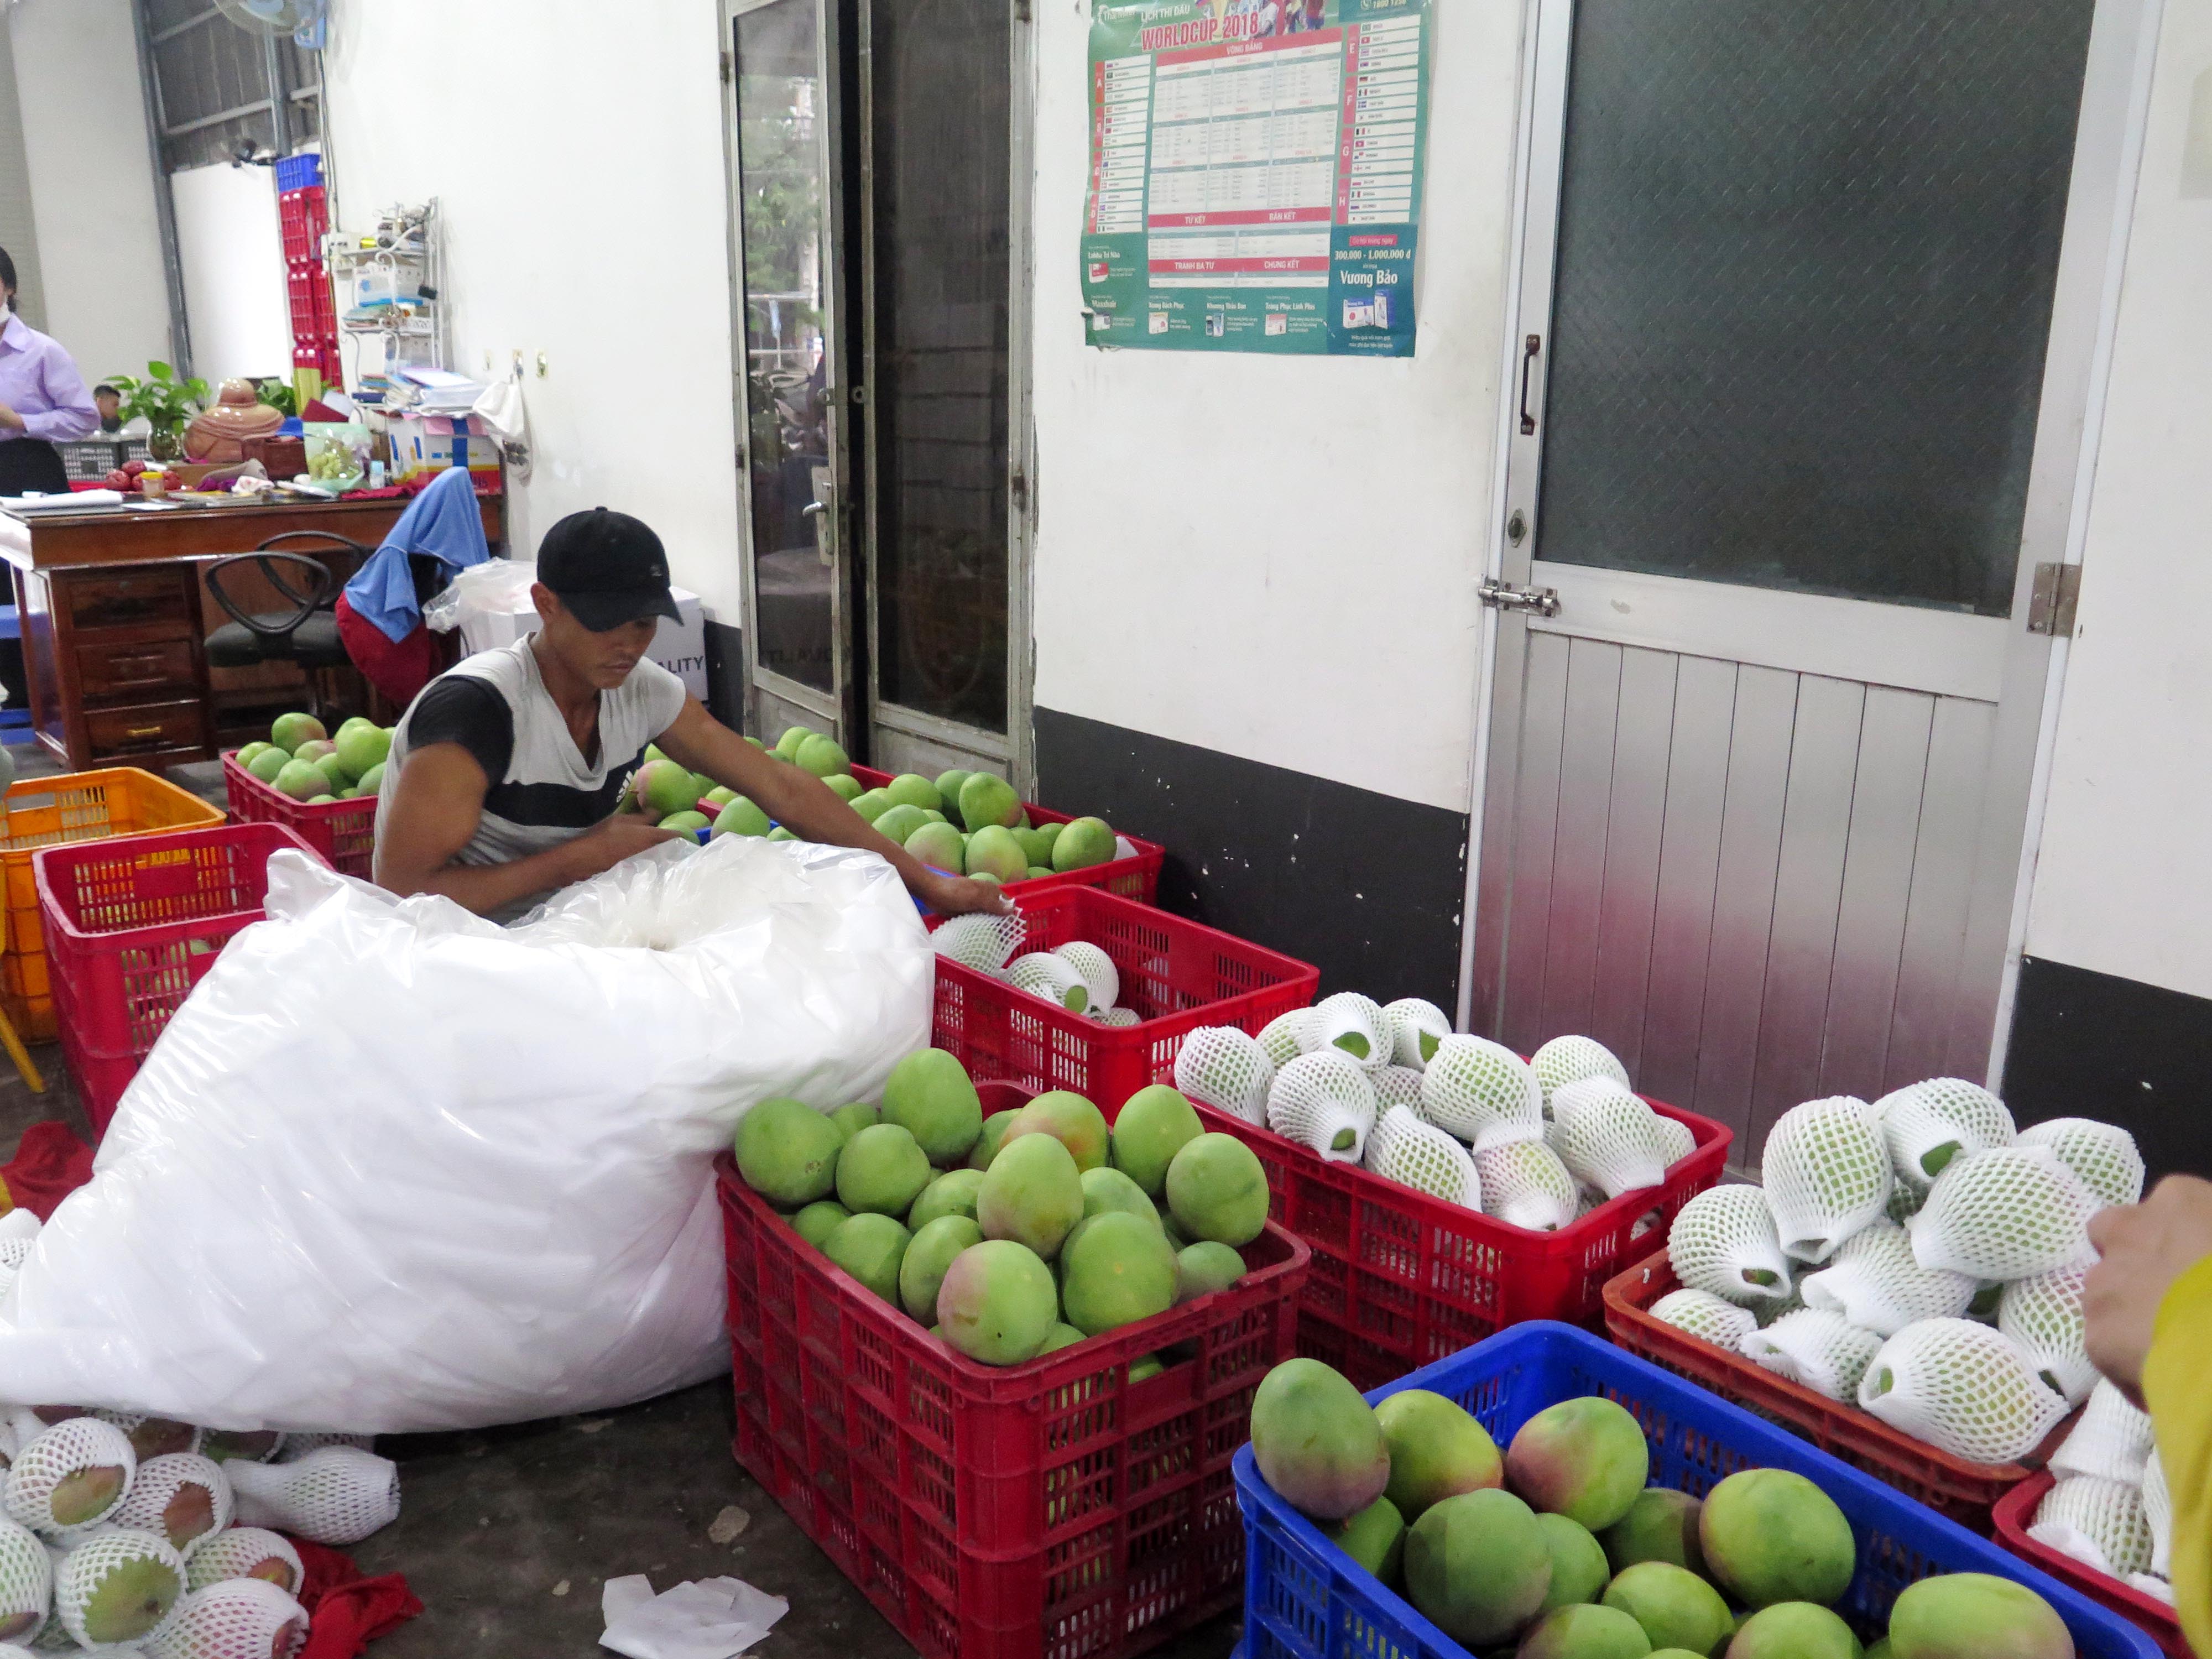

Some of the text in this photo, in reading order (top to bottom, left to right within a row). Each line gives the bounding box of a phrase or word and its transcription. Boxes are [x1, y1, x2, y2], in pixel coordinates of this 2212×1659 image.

[1141, 11, 1259, 52] WORLDCUP 2018
[1343, 145, 1349, 156] G
[1339, 196, 1346, 207] H
[1368, 248, 1404, 260] 1.000.000
[1376, 268, 1398, 284] Bảo
